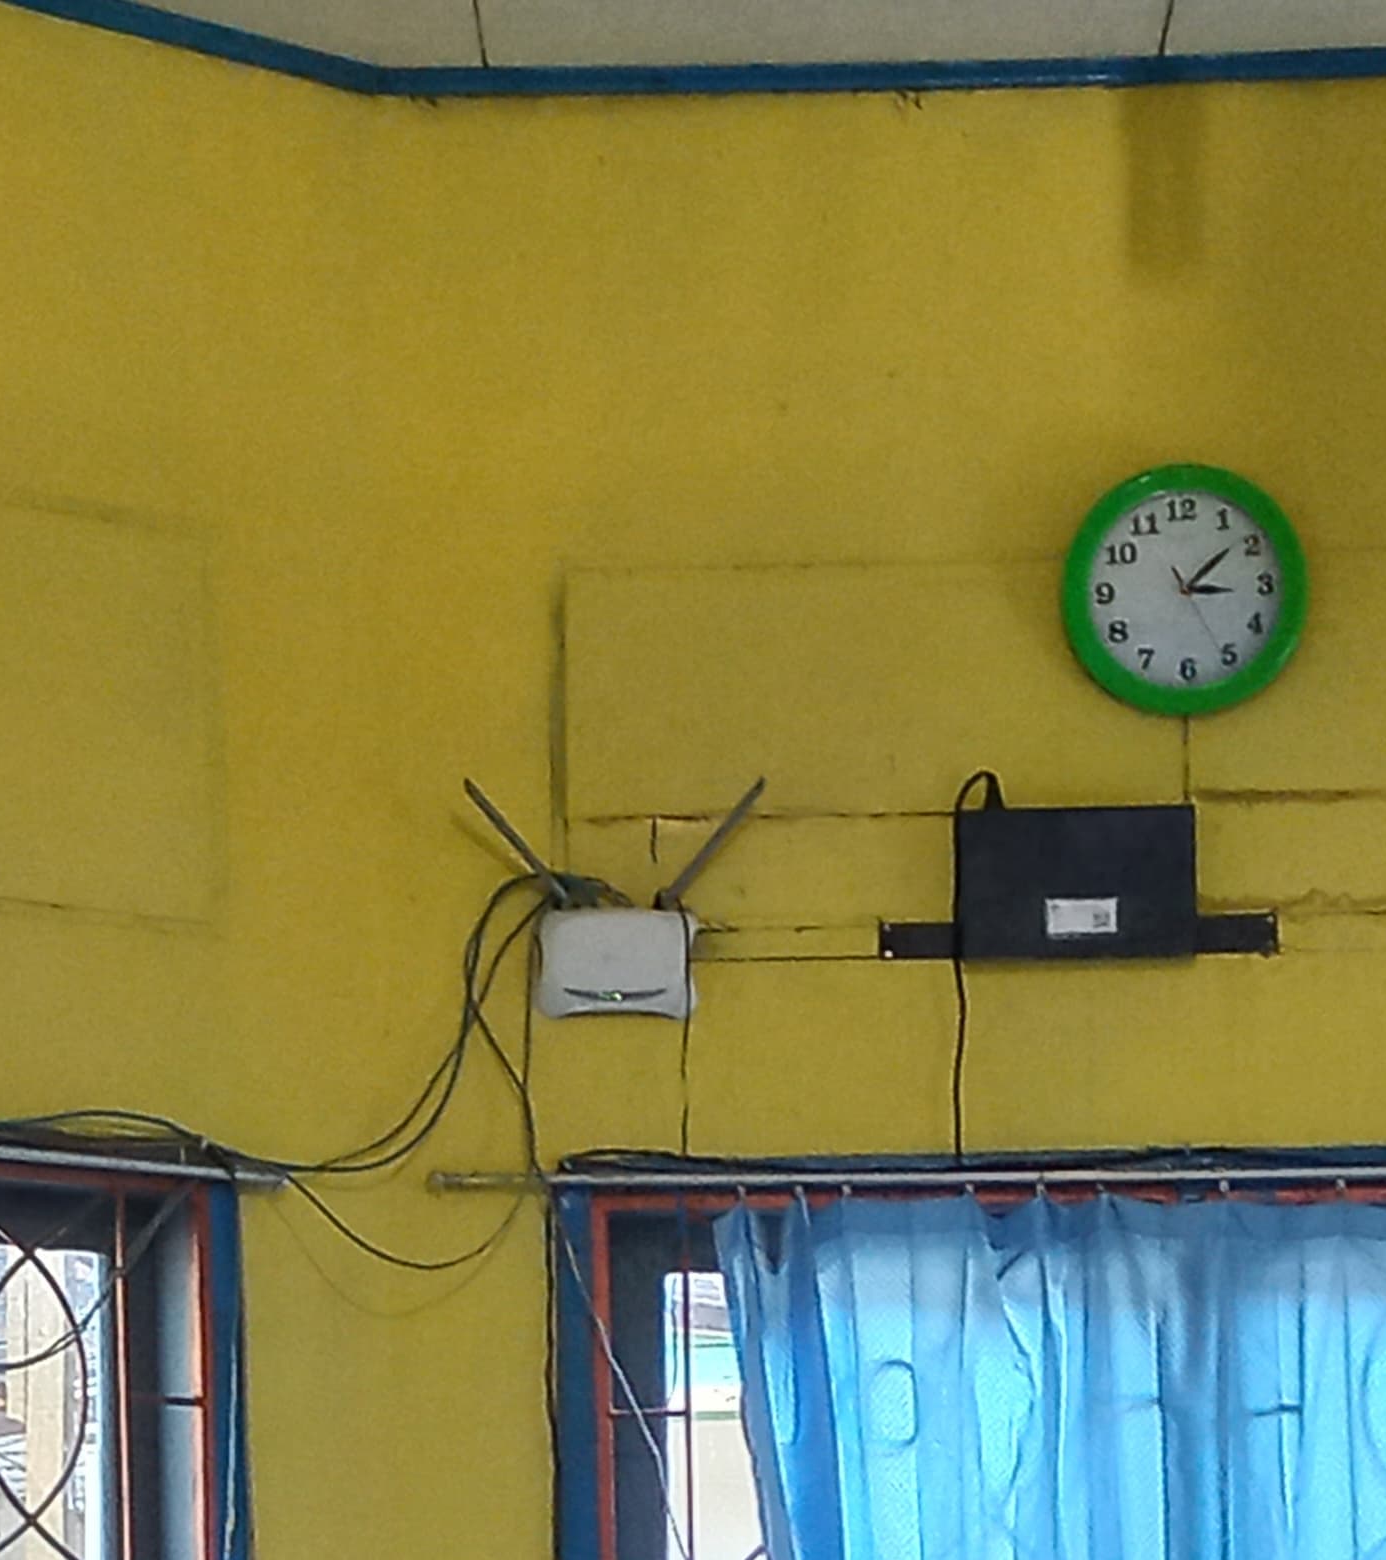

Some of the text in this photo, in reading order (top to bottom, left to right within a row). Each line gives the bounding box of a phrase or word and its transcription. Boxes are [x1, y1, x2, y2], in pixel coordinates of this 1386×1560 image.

[1166, 499, 1197, 522] 12
[1216, 509, 1230, 530] 1
[1131, 513, 1160, 535] 11
[1106, 542, 1137, 565] 10
[1244, 535, 1261, 556] 2
[1095, 582, 1115, 605] 9
[1258, 574, 1274, 595] 3
[1108, 620, 1129, 643] 8
[1247, 612, 1263, 635] 4
[1138, 648, 1155, 670] 7
[1221, 643, 1238, 665] 5
[1180, 658, 1197, 681] 6
